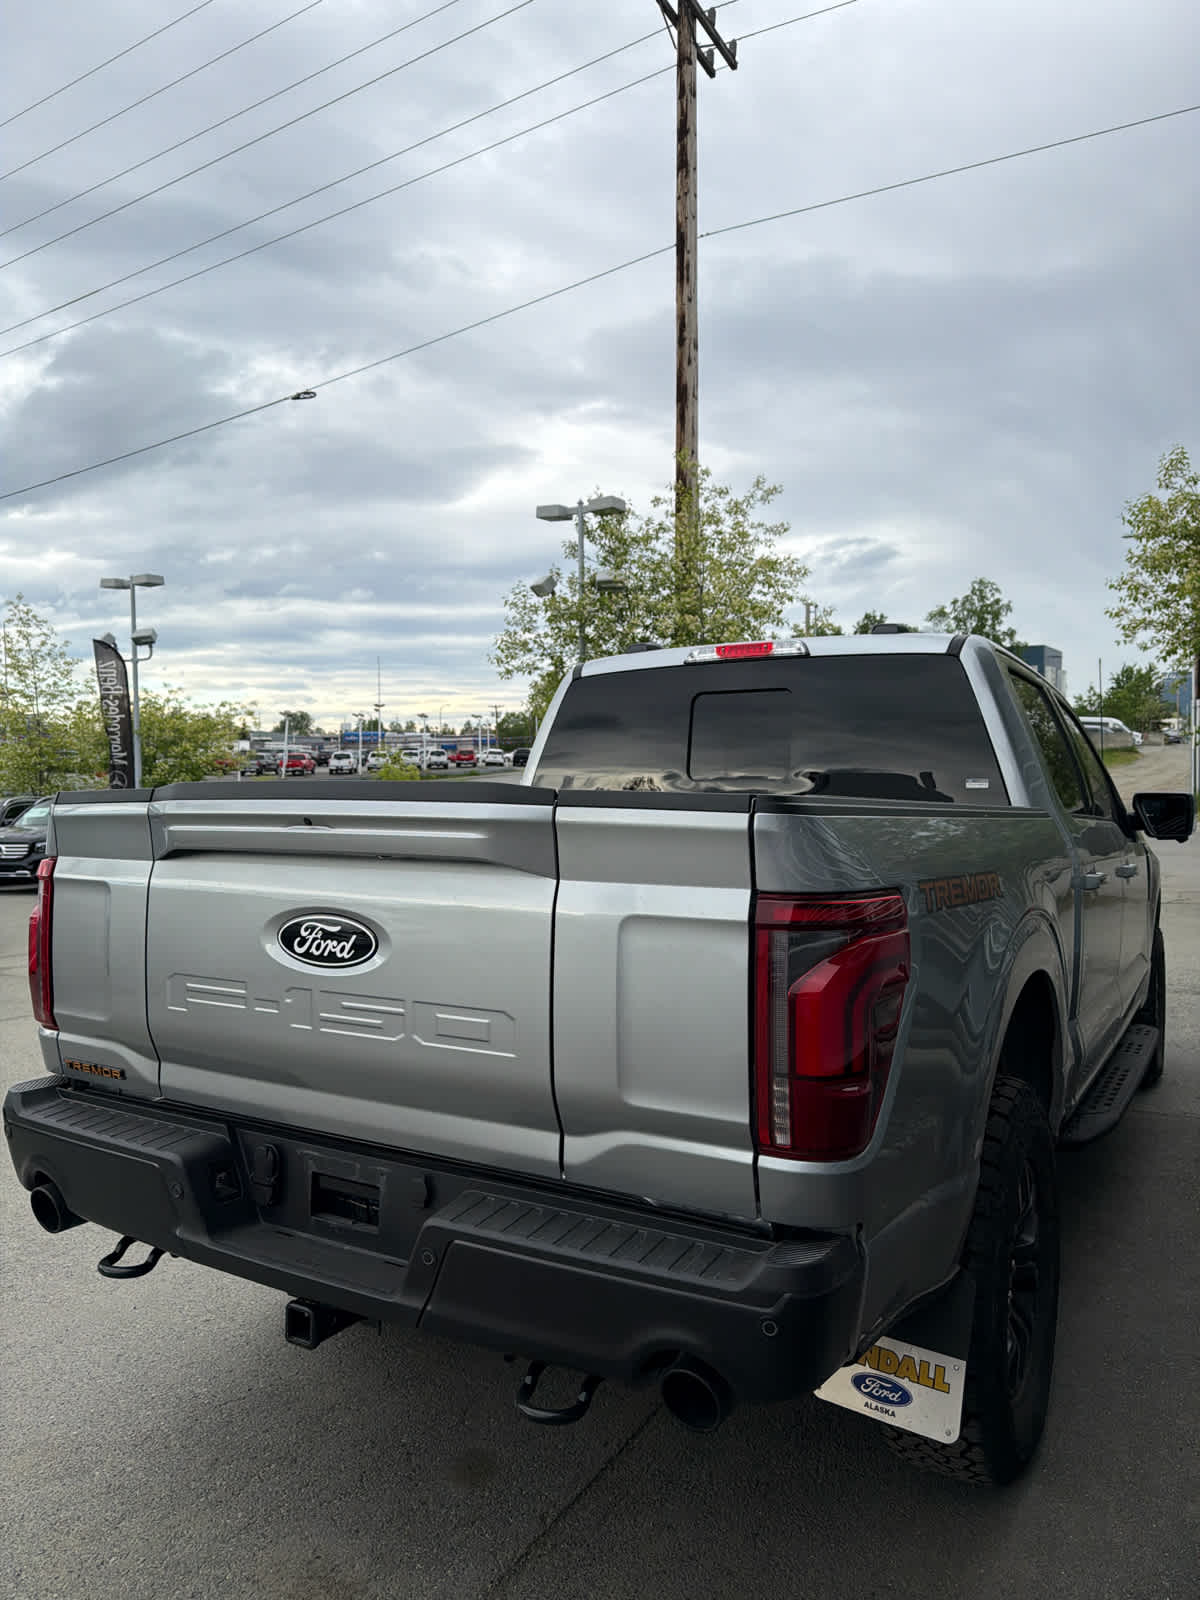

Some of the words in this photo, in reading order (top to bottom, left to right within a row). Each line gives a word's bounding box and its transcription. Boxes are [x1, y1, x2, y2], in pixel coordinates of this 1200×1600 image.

[919, 871, 1002, 912] TREMOR
[293, 921, 357, 960] Ford
[166, 972, 517, 1057] F-150
[63, 1058, 121, 1080] TREMOR
[860, 1376, 902, 1402] Ford
[863, 1401, 896, 1418] ALASKA
